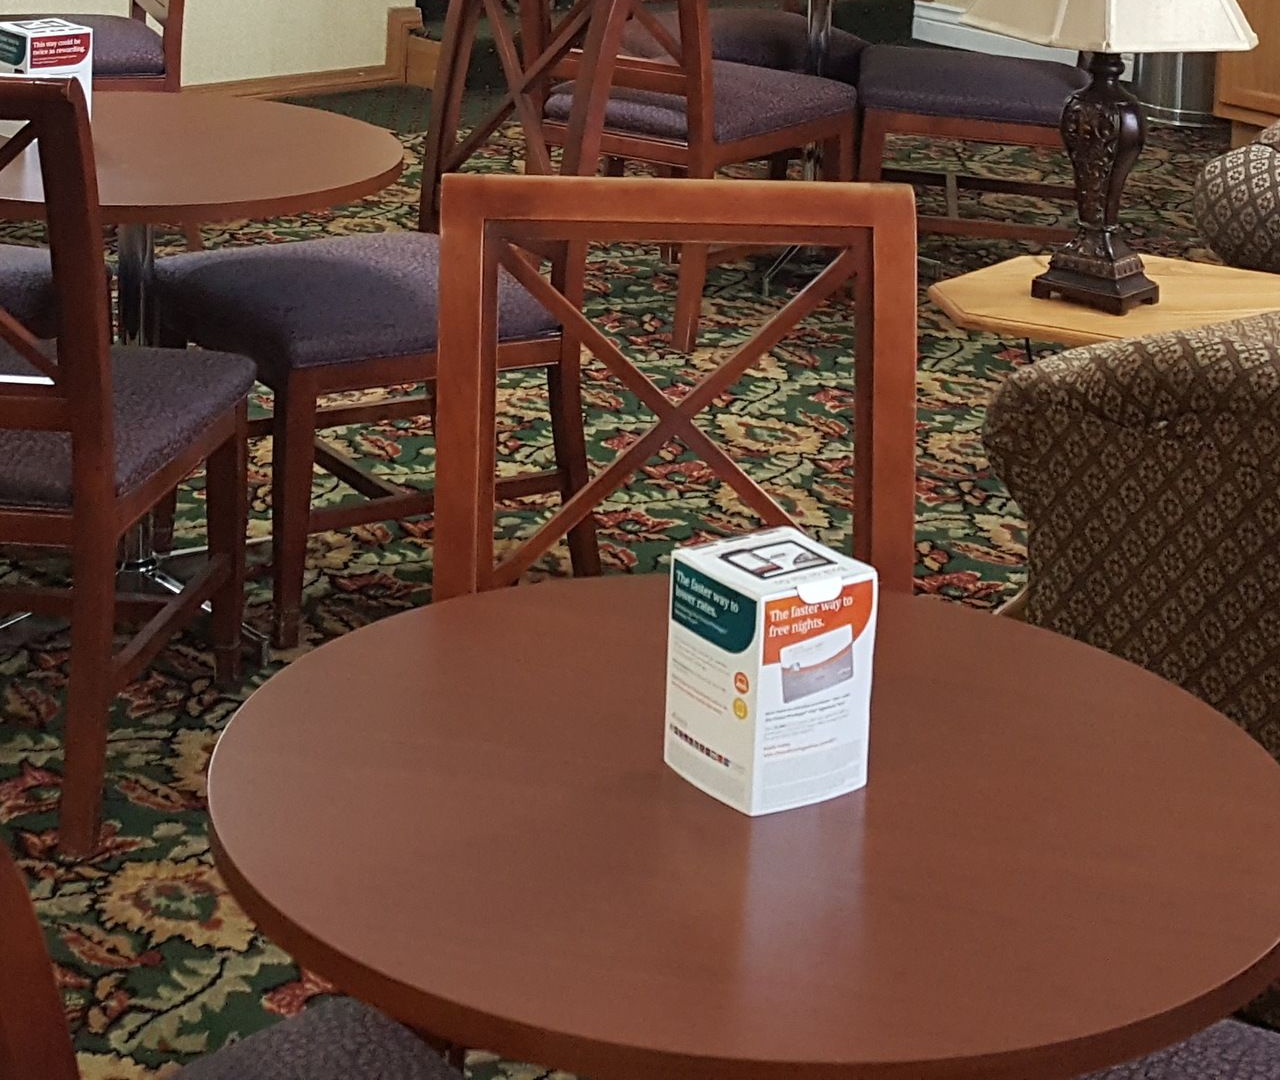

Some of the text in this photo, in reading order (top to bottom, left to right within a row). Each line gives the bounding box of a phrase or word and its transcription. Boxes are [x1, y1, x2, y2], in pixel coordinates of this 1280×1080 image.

[33, 41, 45, 49] This
[58, 39, 73, 47] could
[675, 583, 697, 606] lower
[696, 599, 718, 618] rates.
[676, 569, 739, 614] The faster way to
[770, 595, 854, 622] The faster way to
[768, 617, 825, 638] free nights.
